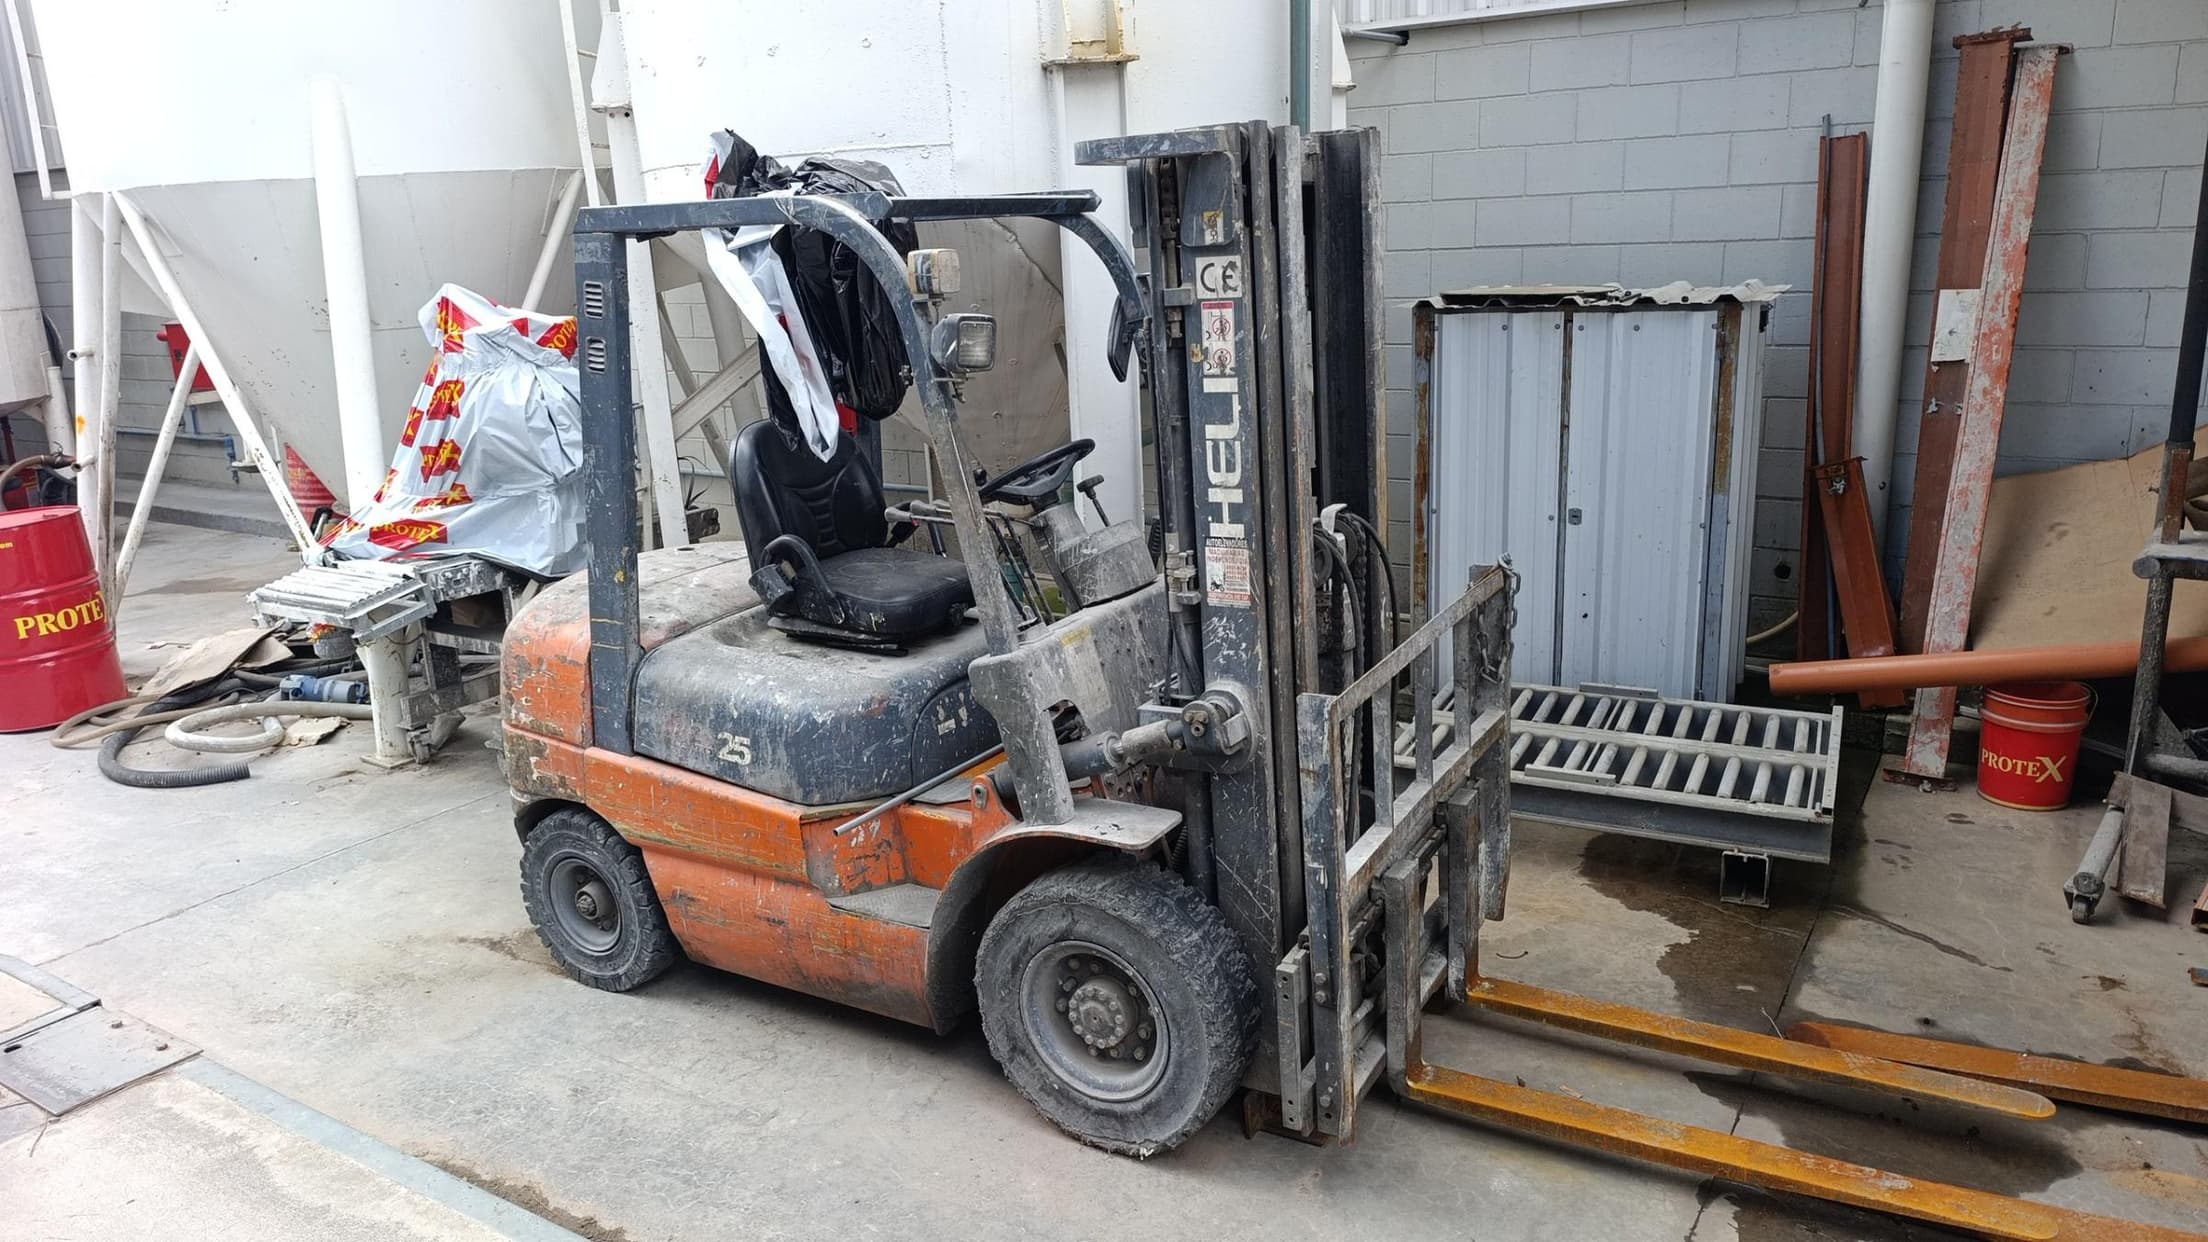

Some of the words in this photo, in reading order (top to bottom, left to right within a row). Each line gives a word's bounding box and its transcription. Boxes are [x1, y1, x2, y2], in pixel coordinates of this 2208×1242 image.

[1201, 260, 1239, 292] CE
[1203, 377, 1245, 538] HELI
[717, 731, 752, 766] 25
[1981, 748, 2067, 783] PROTEX
